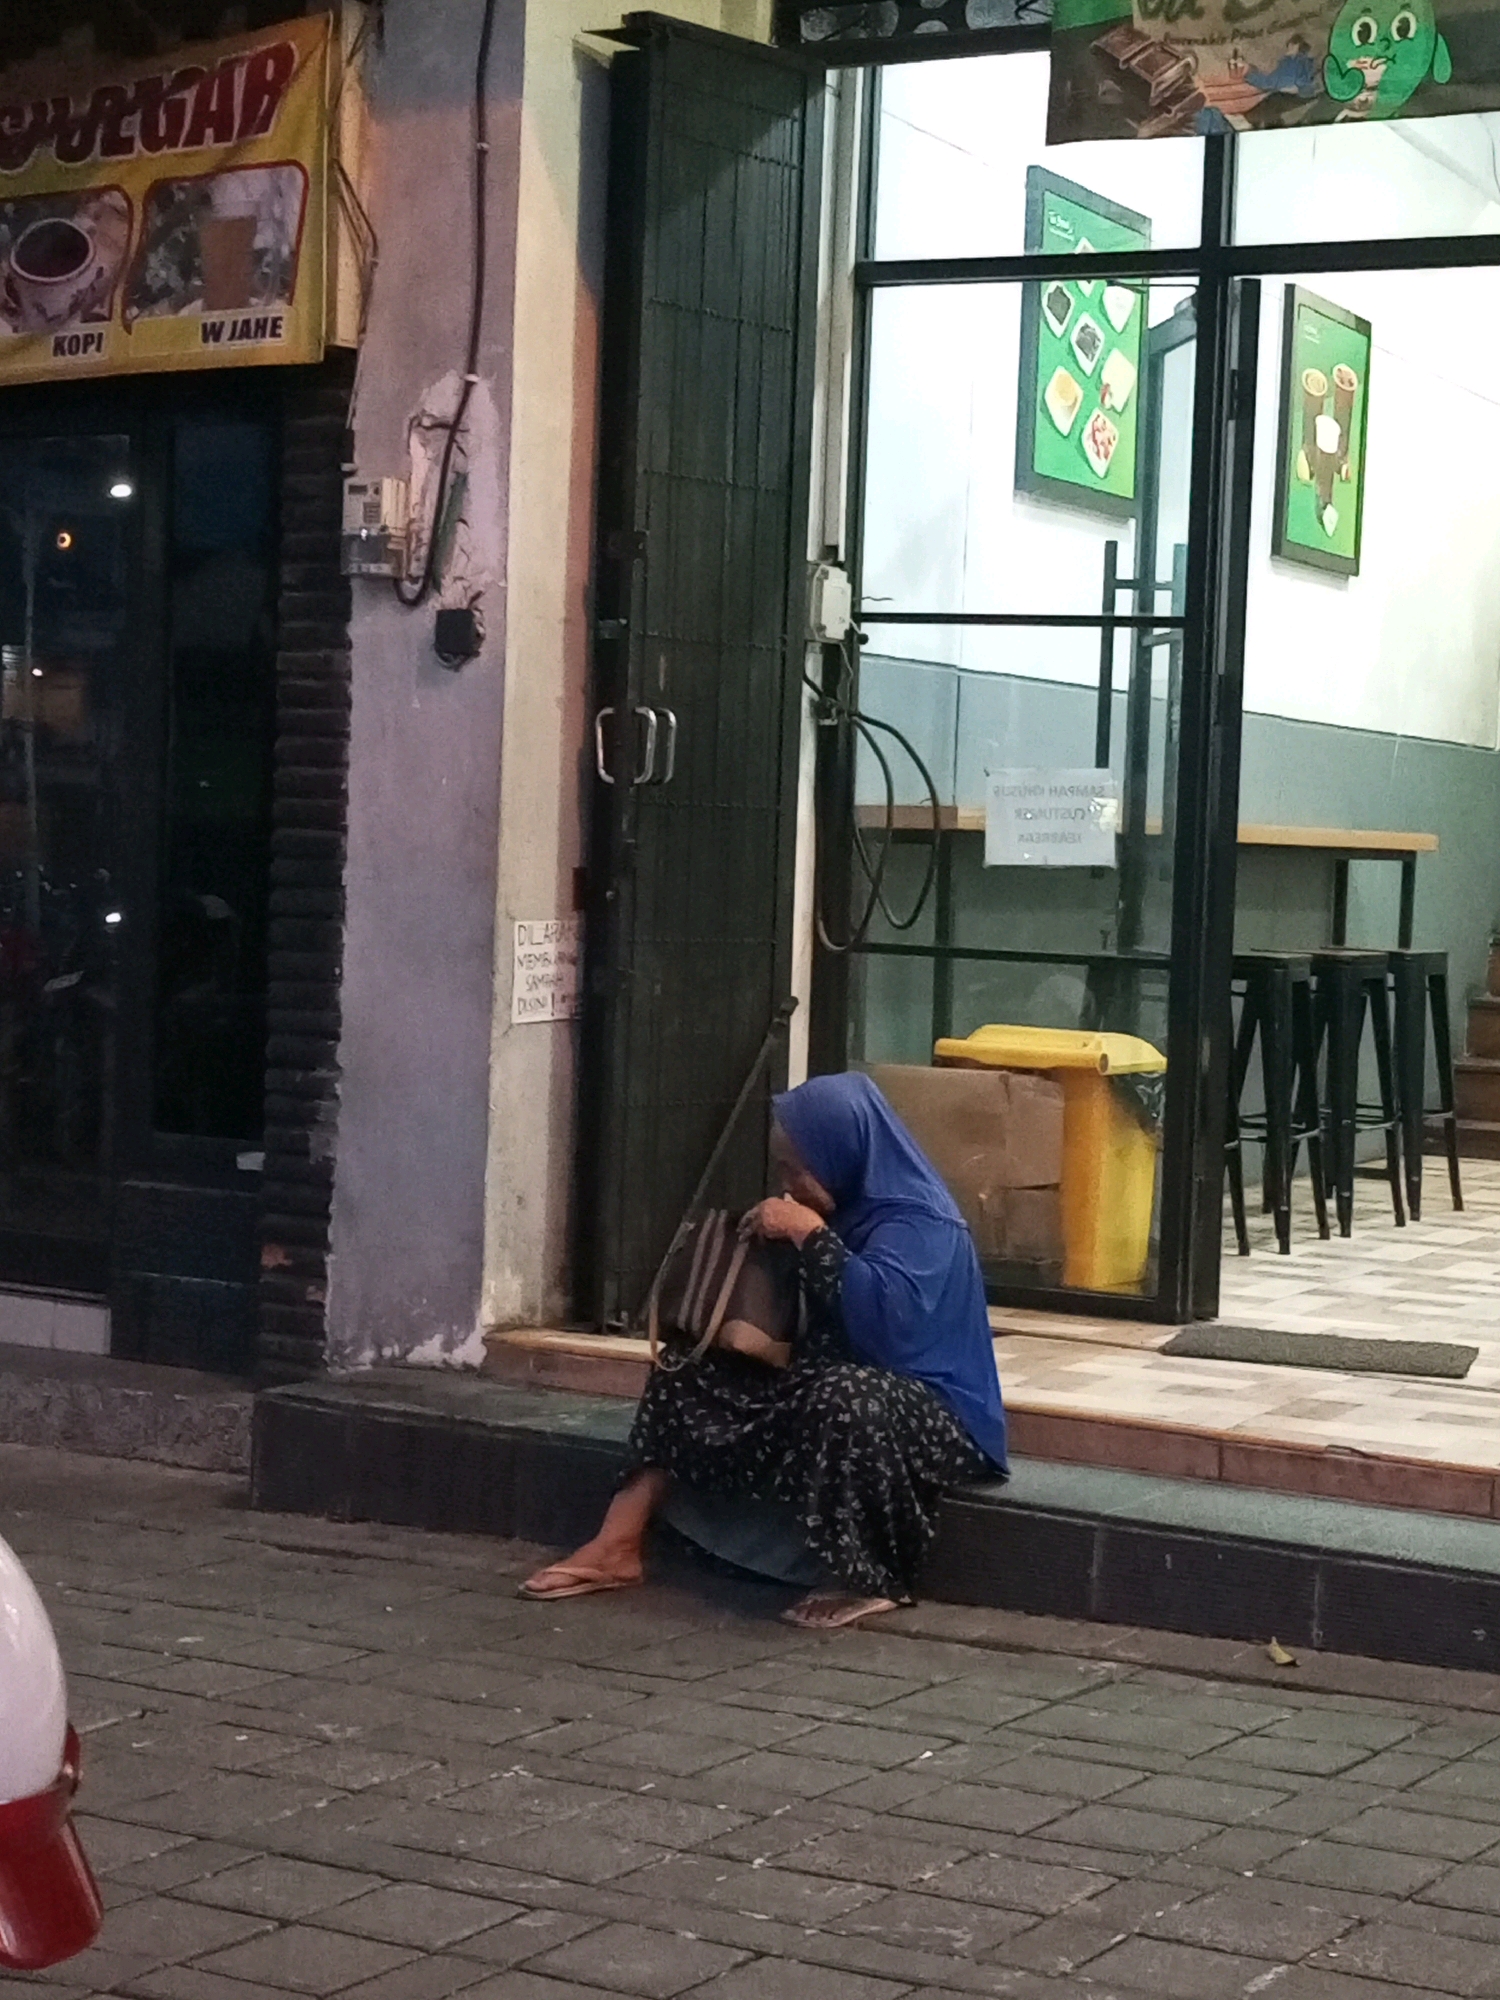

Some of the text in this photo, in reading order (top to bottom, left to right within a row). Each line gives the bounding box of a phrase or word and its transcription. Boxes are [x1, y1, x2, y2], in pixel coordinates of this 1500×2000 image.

[201, 316, 283, 344] W JAHE
[52, 332, 104, 357] KOPI
